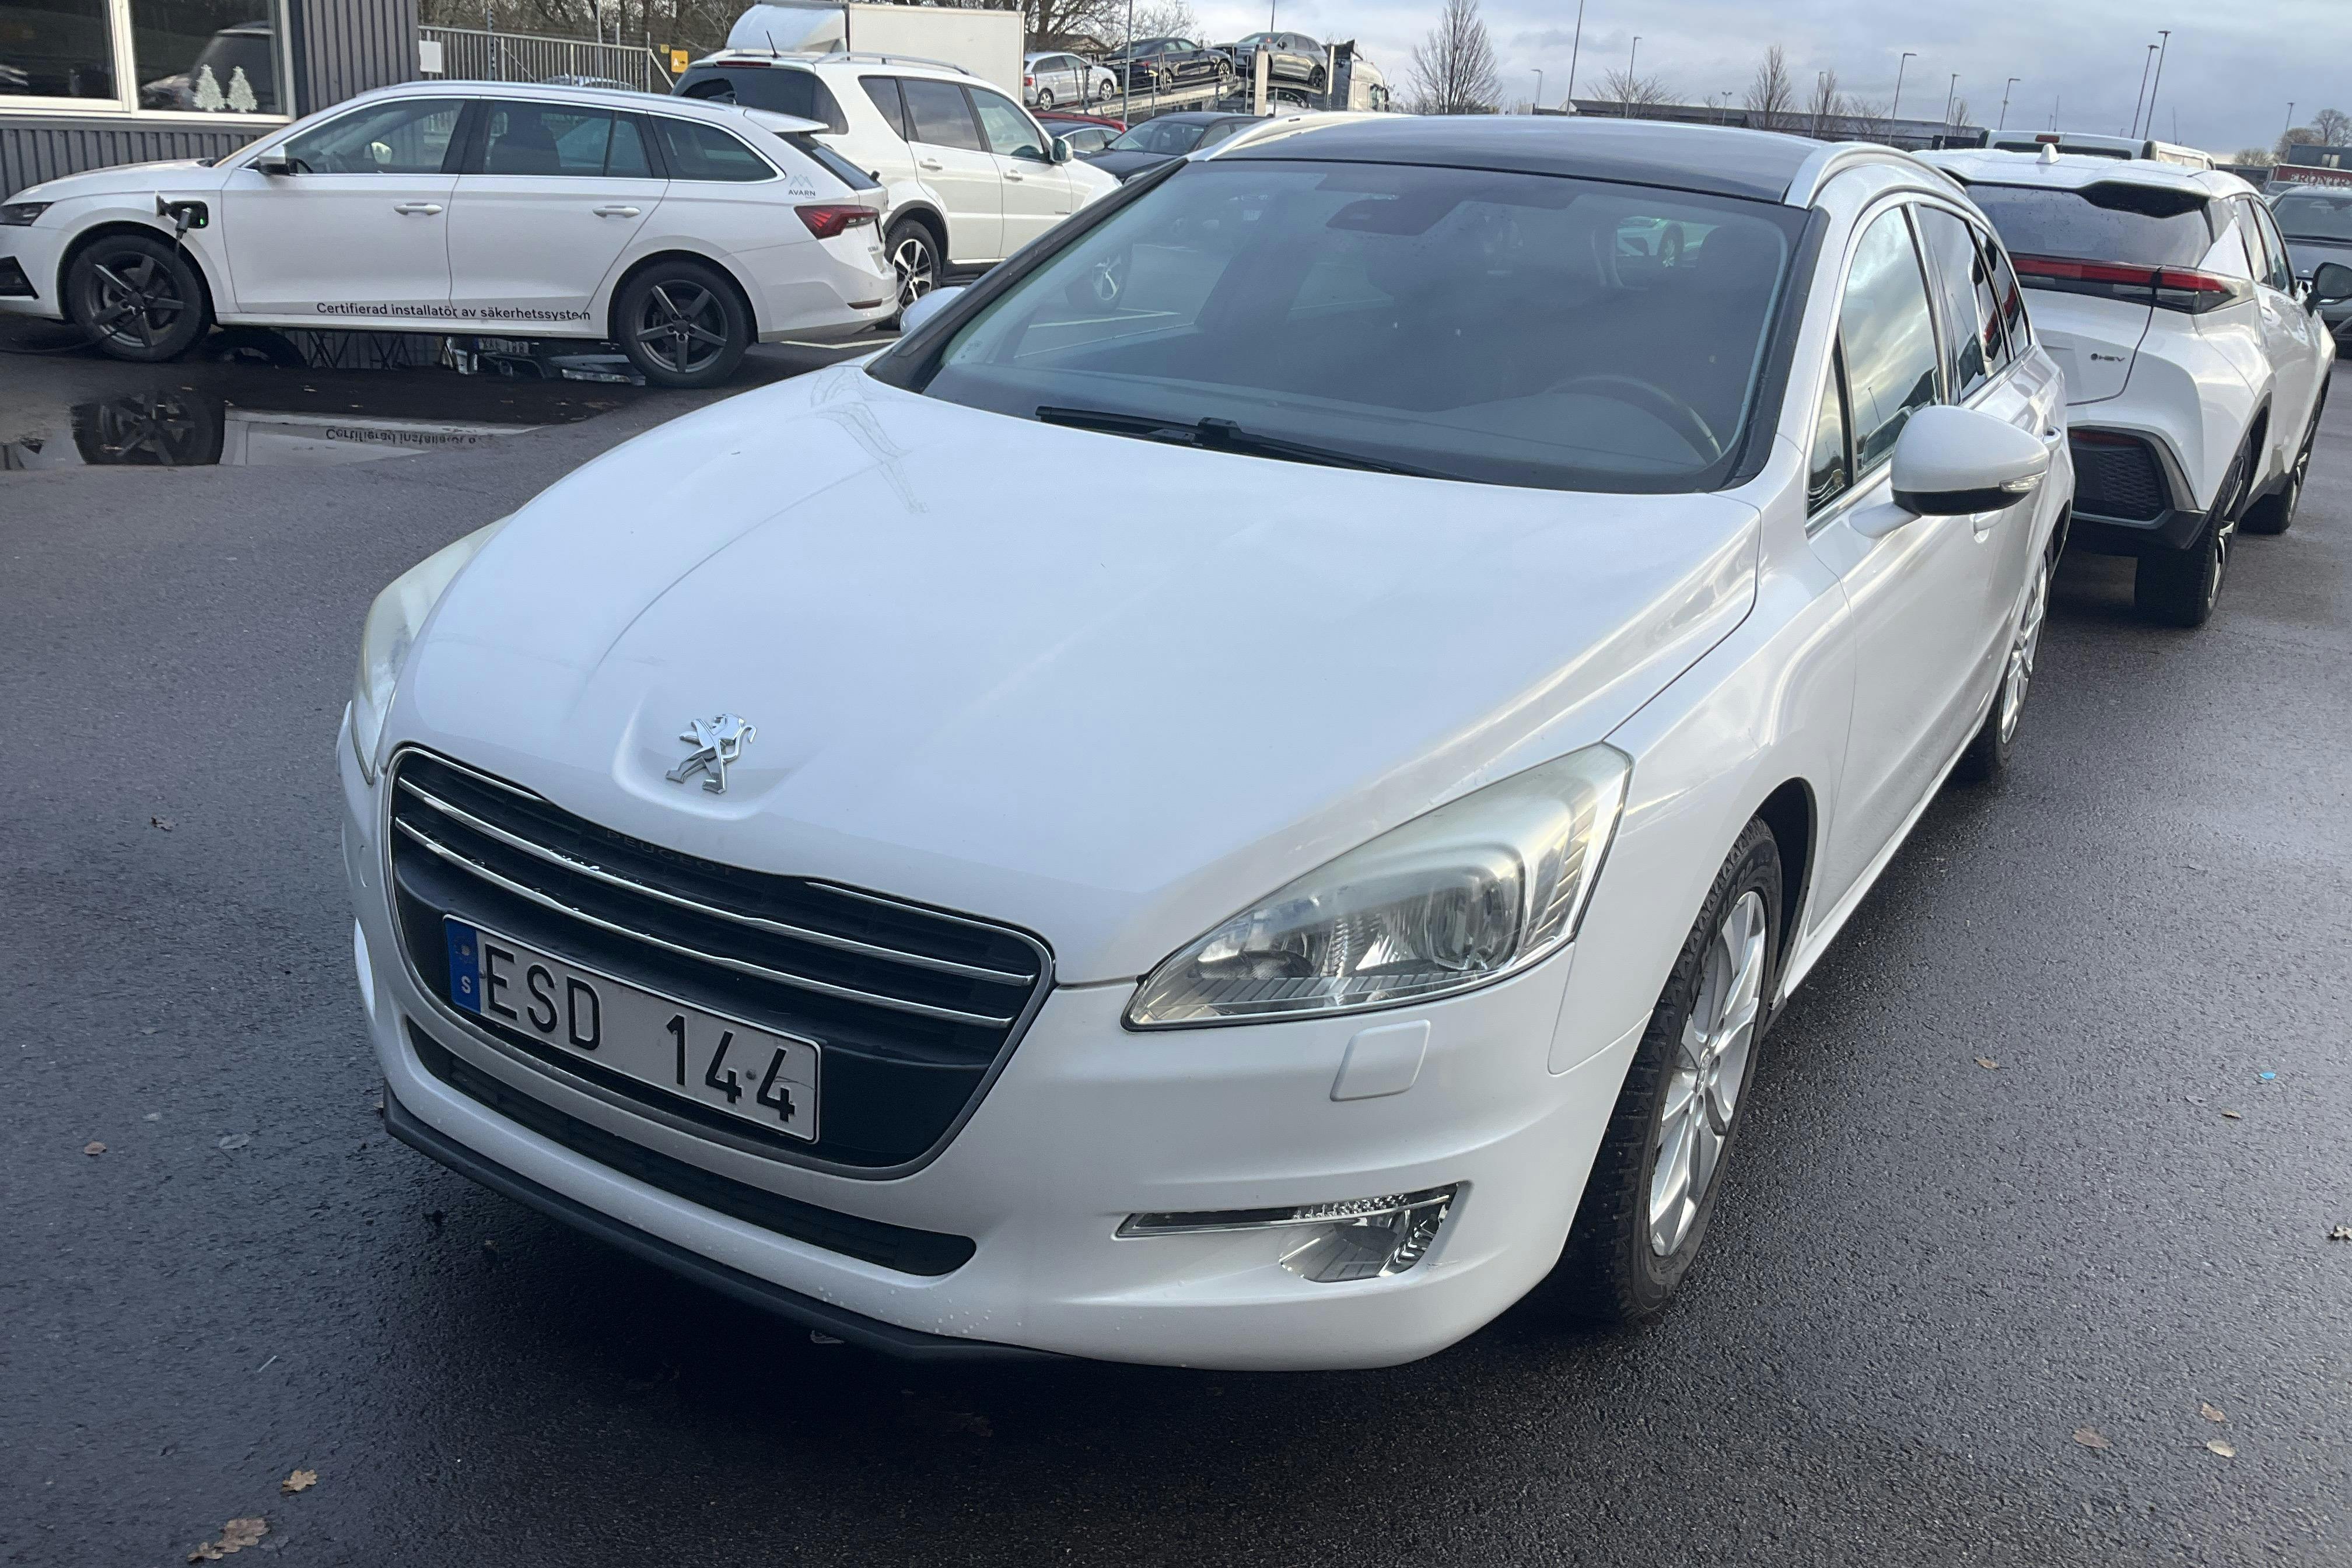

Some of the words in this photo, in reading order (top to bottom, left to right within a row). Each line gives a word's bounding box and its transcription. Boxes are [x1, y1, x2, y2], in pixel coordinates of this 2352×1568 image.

[673, 58, 679, 66] A
[317, 302, 387, 314] Certifierad
[391, 303, 457, 317] installatör
[461, 309, 476, 317] av
[480, 306, 590, 321] säkerhetssystem
[460, 975, 471, 995] S
[485, 943, 601, 1051] ESD
[666, 1014, 796, 1122] 144
